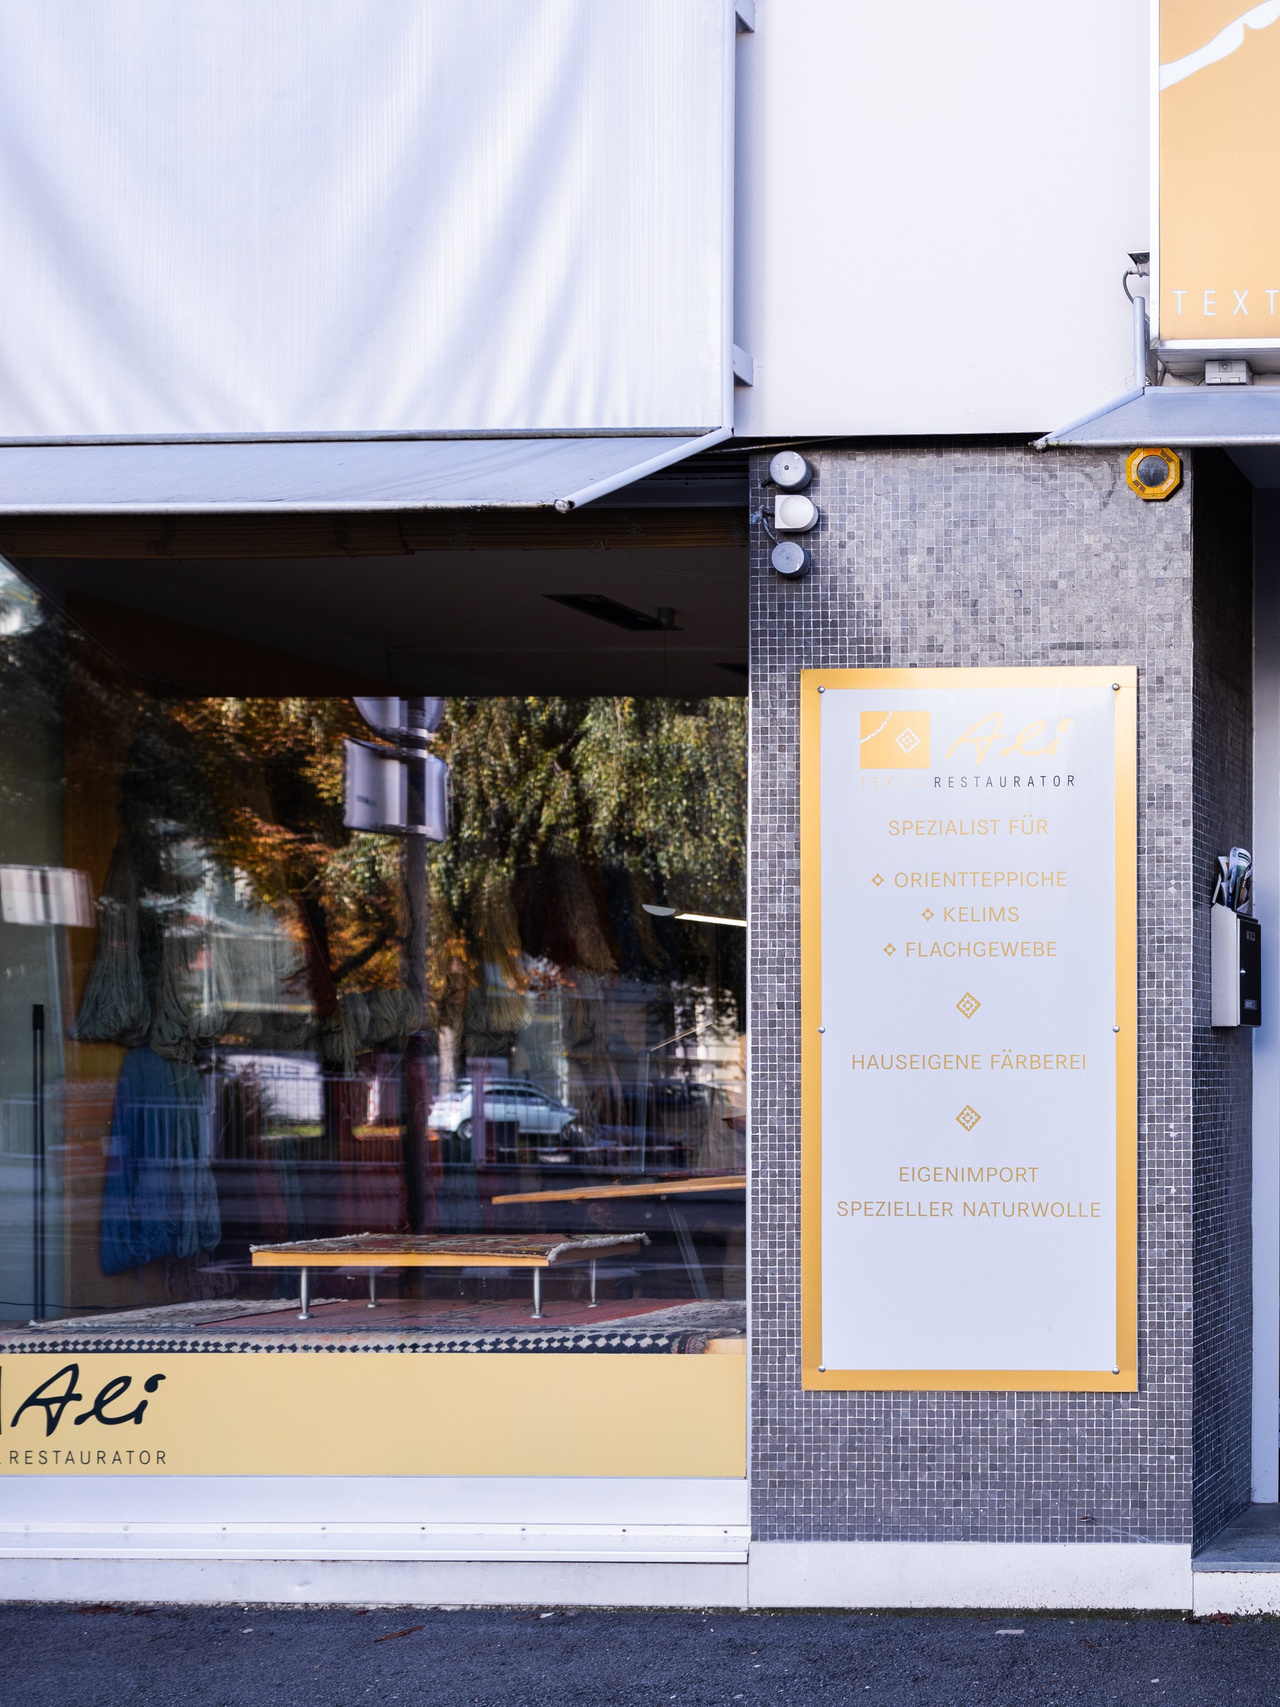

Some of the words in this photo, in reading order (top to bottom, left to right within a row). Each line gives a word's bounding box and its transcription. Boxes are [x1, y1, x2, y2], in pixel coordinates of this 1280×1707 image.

[944, 710, 1075, 766] Ali
[888, 819, 1000, 837] SPEZIALIST
[1009, 813, 1048, 835] FÜR
[894, 870, 1066, 889] ORIENTTEPPICHE
[943, 906, 1020, 923] KELIMS
[905, 941, 1057, 958] FLACHGEWEBE
[851, 1053, 981, 1071] HAUSEIGENE
[990, 1049, 1086, 1070] FÄRBEREI
[899, 1166, 1039, 1183] EIGENIMPORT
[837, 1200, 953, 1218] SPEZIELLER
[962, 1201, 1101, 1218] NATURWOLLE
[10, 1363, 167, 1437] Ali
[0, 1450, 167, 1465] RESTAURATOR
